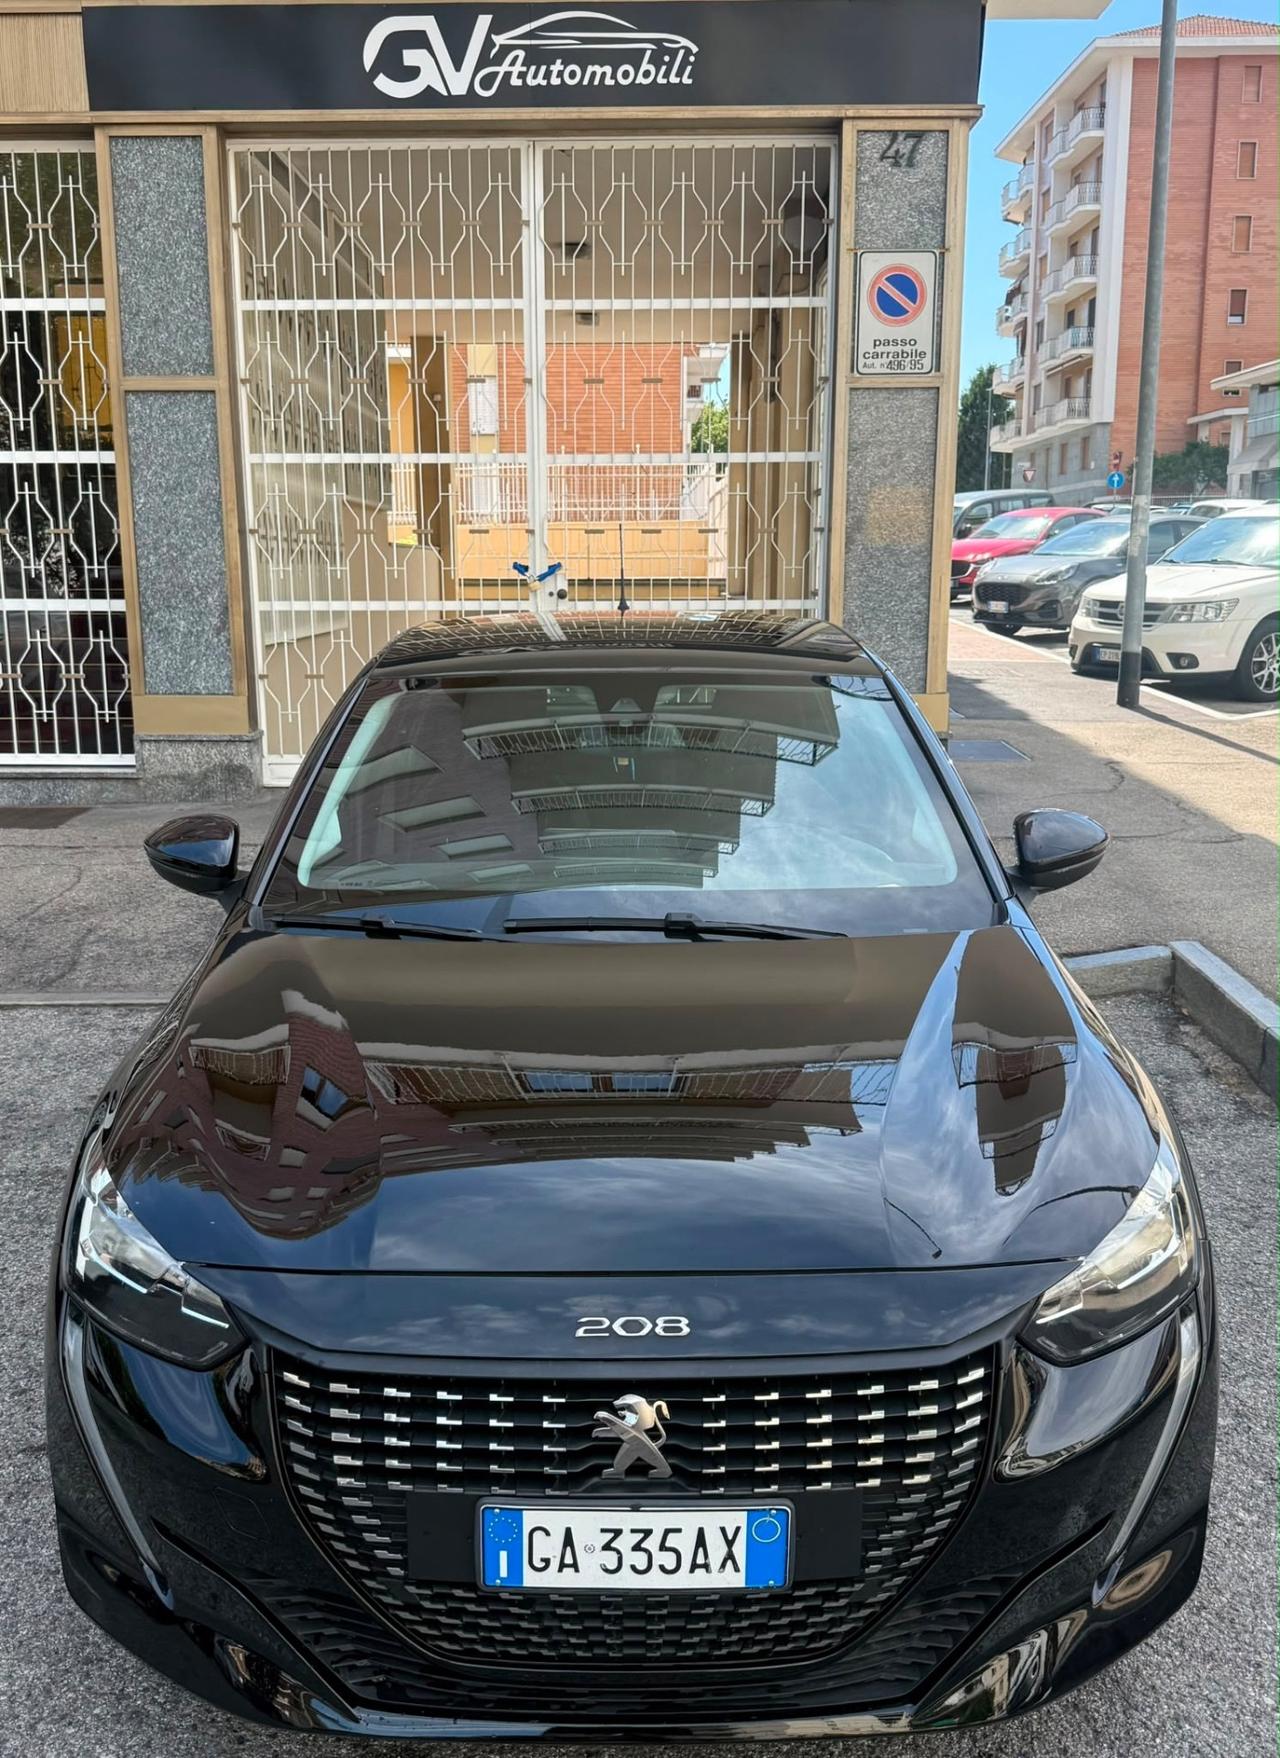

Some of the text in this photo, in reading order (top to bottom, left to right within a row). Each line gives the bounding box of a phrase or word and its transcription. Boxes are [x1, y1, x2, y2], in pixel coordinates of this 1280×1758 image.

[363, 14, 696, 98] GV Automobili
[880, 131, 925, 168] 47
[862, 349, 927, 359] carrabile
[873, 338, 917, 349] passo
[575, 1316, 690, 1337] 208
